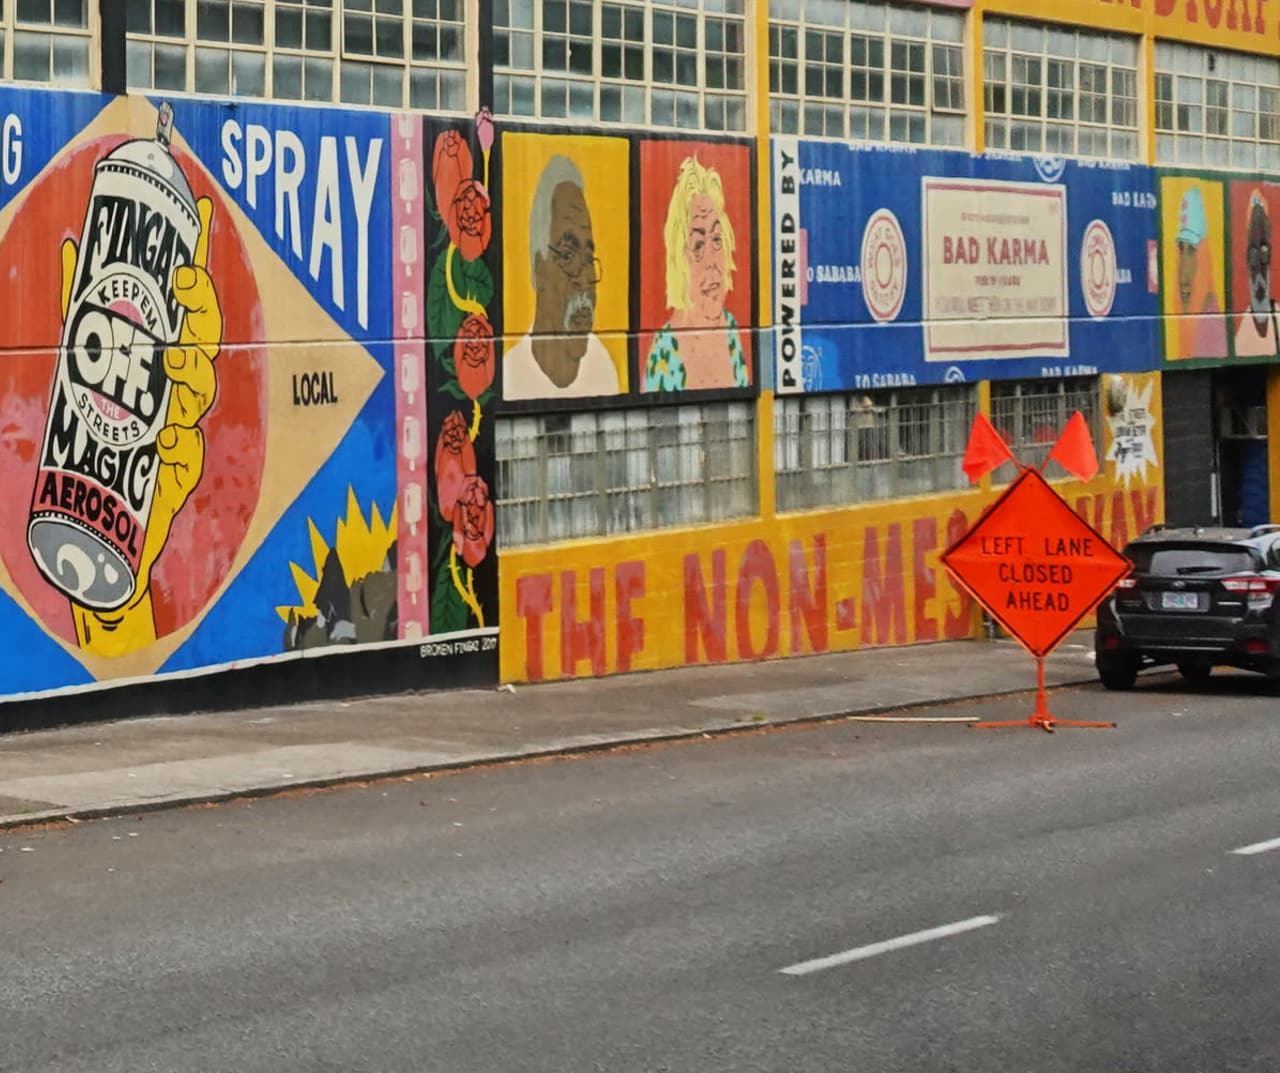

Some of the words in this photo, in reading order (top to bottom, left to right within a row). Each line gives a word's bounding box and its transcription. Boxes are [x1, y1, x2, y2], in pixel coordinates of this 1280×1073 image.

[781, 149, 795, 194] BY
[221, 119, 383, 332] SPRAY
[943, 235, 980, 265] BAD
[986, 237, 1049, 266] KARMA
[781, 212, 797, 387] POWERED
[100, 398, 120, 419] THE
[292, 371, 338, 406] LOCAL
[78, 392, 141, 441] STREETS
[43, 380, 158, 512] MAGIC
[39, 472, 139, 558] AEROSOL
[981, 536, 1025, 556] LEFT
[1044, 538, 1094, 558] LANE
[998, 563, 1073, 584] CLOSED
[1006, 592, 1070, 612] AHEAD
